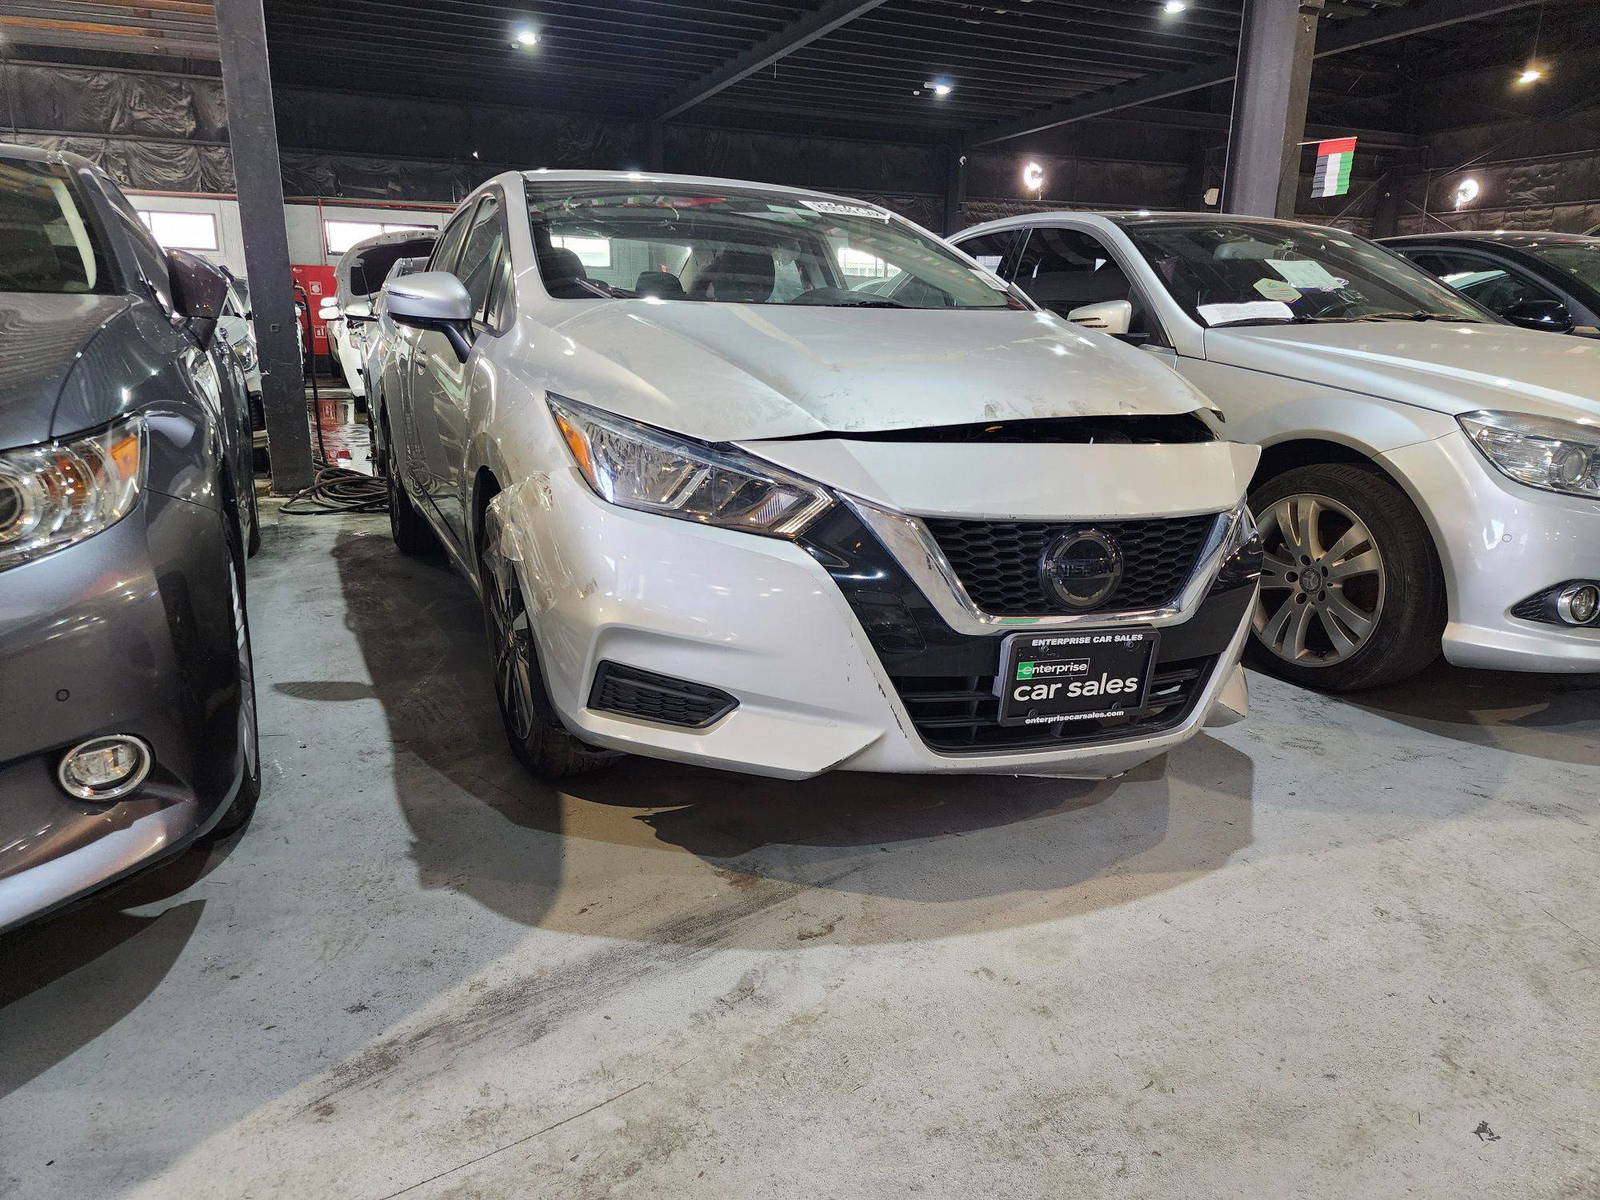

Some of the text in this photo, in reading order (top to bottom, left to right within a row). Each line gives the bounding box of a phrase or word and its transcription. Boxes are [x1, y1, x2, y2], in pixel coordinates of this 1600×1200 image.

[1031, 633, 1143, 647] ENTERPRISE CAR SALES
[1021, 661, 1088, 676] enterprise
[1013, 672, 1139, 702] car sales
[1024, 710, 1124, 725] enterprisecarsales.com
